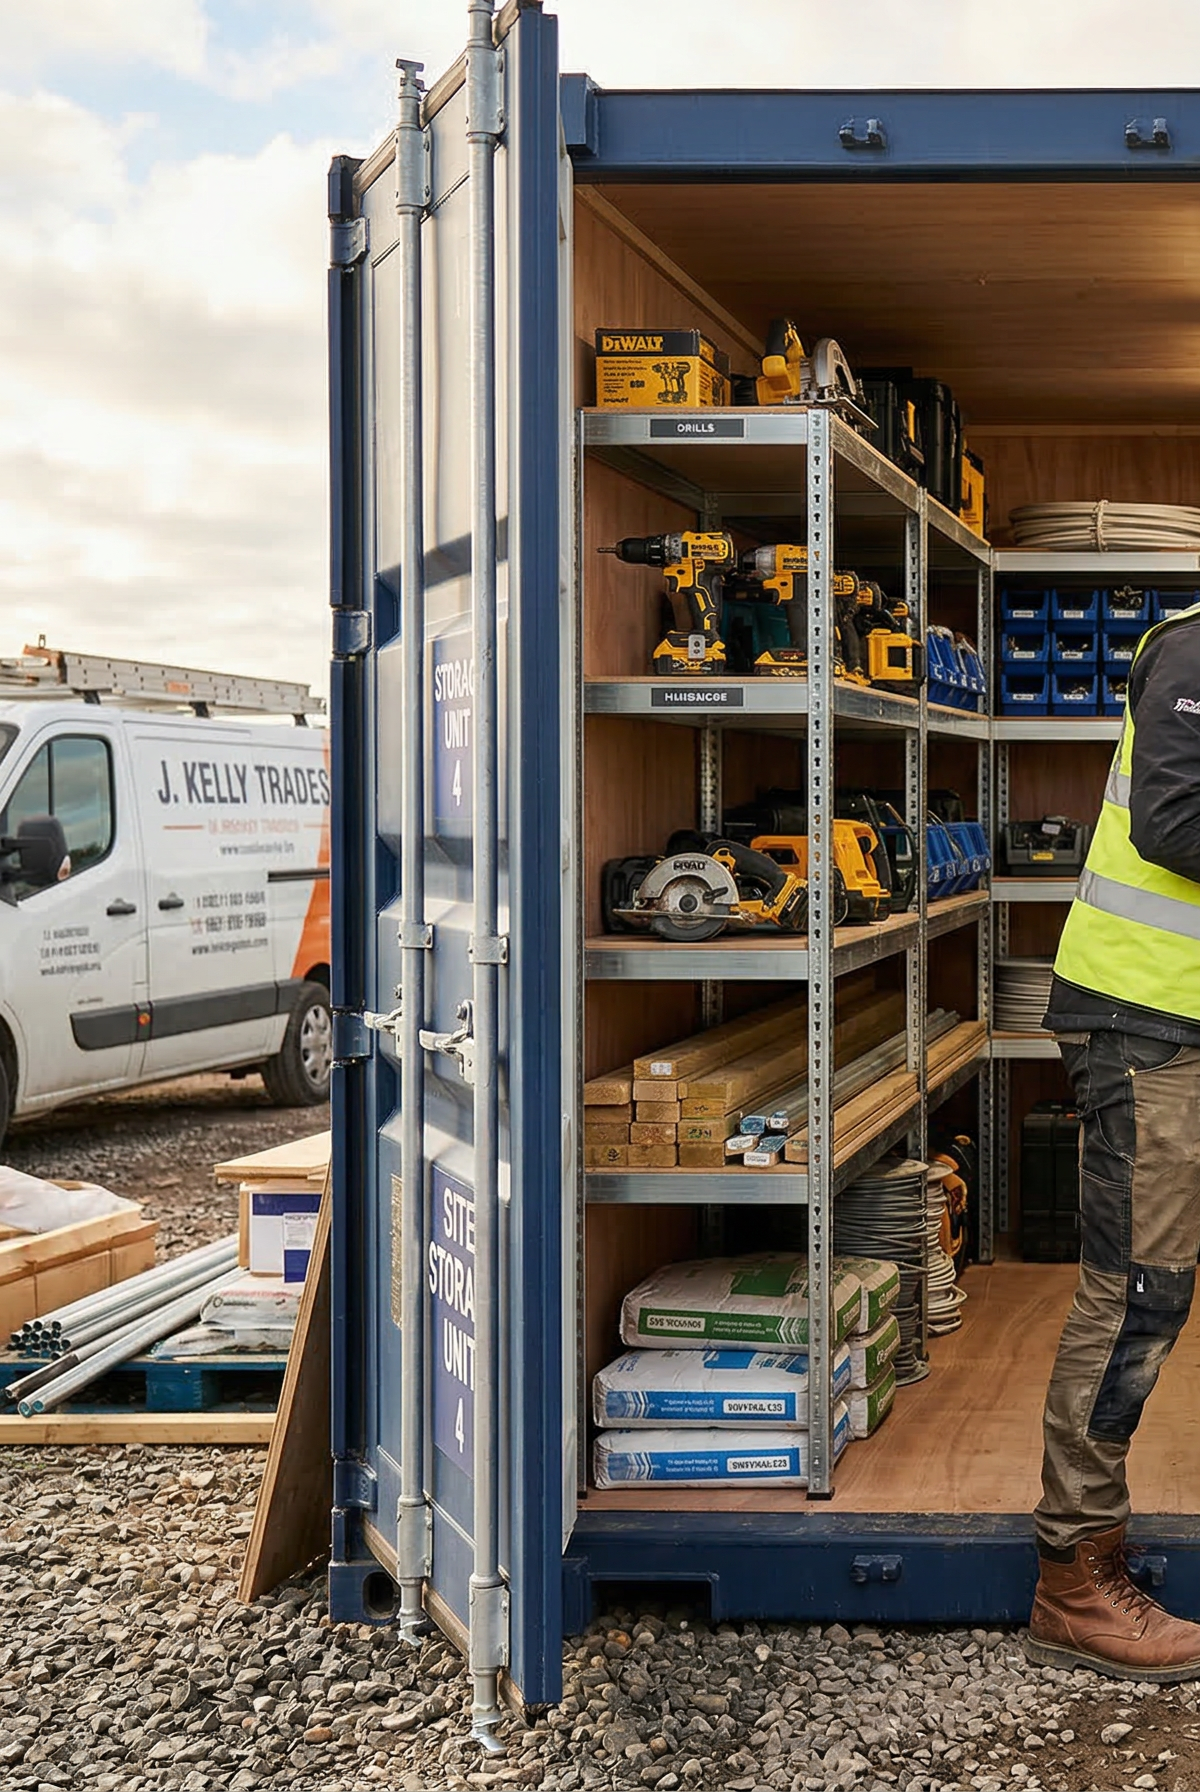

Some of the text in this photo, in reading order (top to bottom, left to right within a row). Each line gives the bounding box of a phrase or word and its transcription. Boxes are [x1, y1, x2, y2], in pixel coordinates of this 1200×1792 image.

[435, 659, 474, 702] STORAG
[444, 708, 471, 749] UNIT
[158, 760, 330, 806] J. KELLY TRADES
[452, 760, 462, 806] 4
[443, 1187, 475, 1254] SITE
[429, 1241, 475, 1323] STORA
[444, 1318, 475, 1391] UNIT
[455, 1397, 465, 1453] 4
